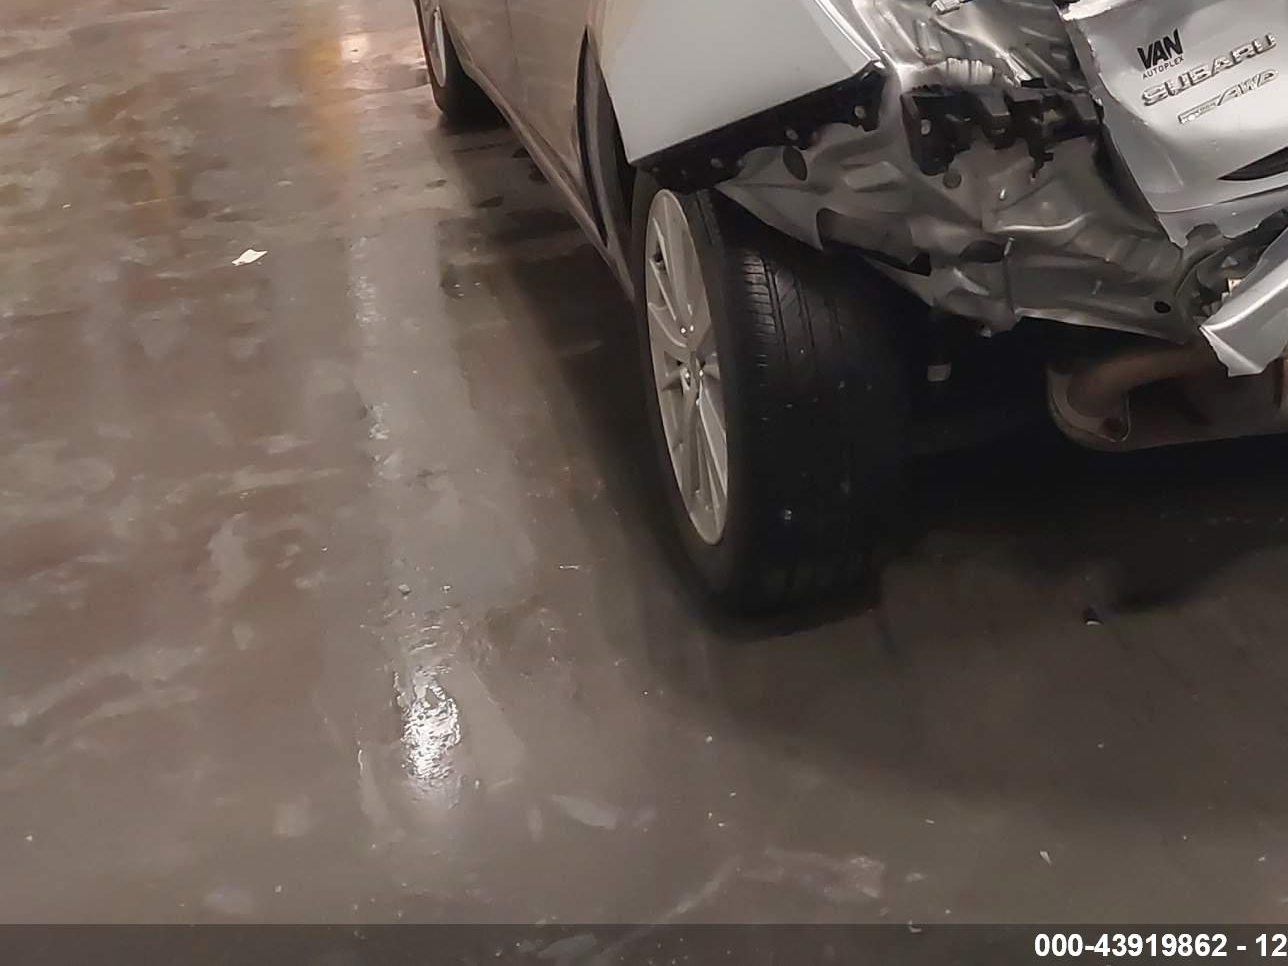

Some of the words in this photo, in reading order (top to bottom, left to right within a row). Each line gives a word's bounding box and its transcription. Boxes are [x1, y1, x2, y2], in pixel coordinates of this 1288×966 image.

[1136, 27, 1184, 70] VAN
[1142, 55, 1185, 81] AUTOPLEX
[1141, 33, 1277, 106] SUBARU
[1216, 69, 1279, 107] AWD
